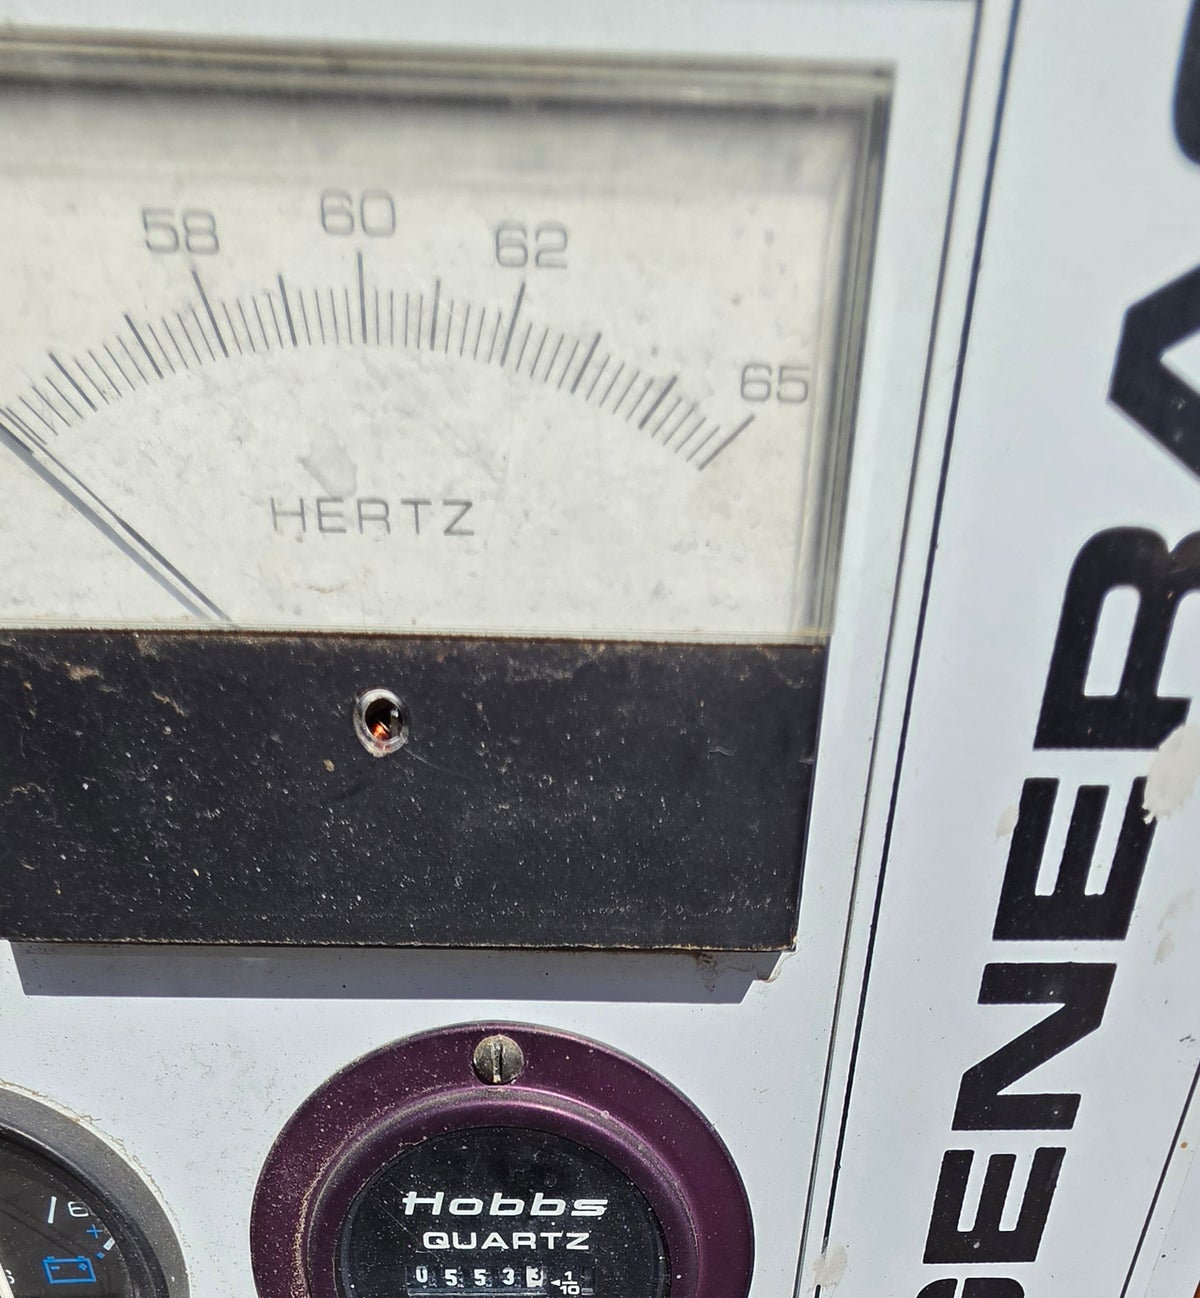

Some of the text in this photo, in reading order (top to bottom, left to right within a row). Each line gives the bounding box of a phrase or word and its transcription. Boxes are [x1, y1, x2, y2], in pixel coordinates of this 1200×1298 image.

[143, 208, 219, 255] 58
[321, 190, 396, 237] 60
[494, 221, 568, 269] 62
[740, 363, 810, 404] 65
[271, 497, 475, 537] HERTZ
[402, 1191, 608, 1217] Hobbs
[423, 1231, 590, 1250] QUARTZ
